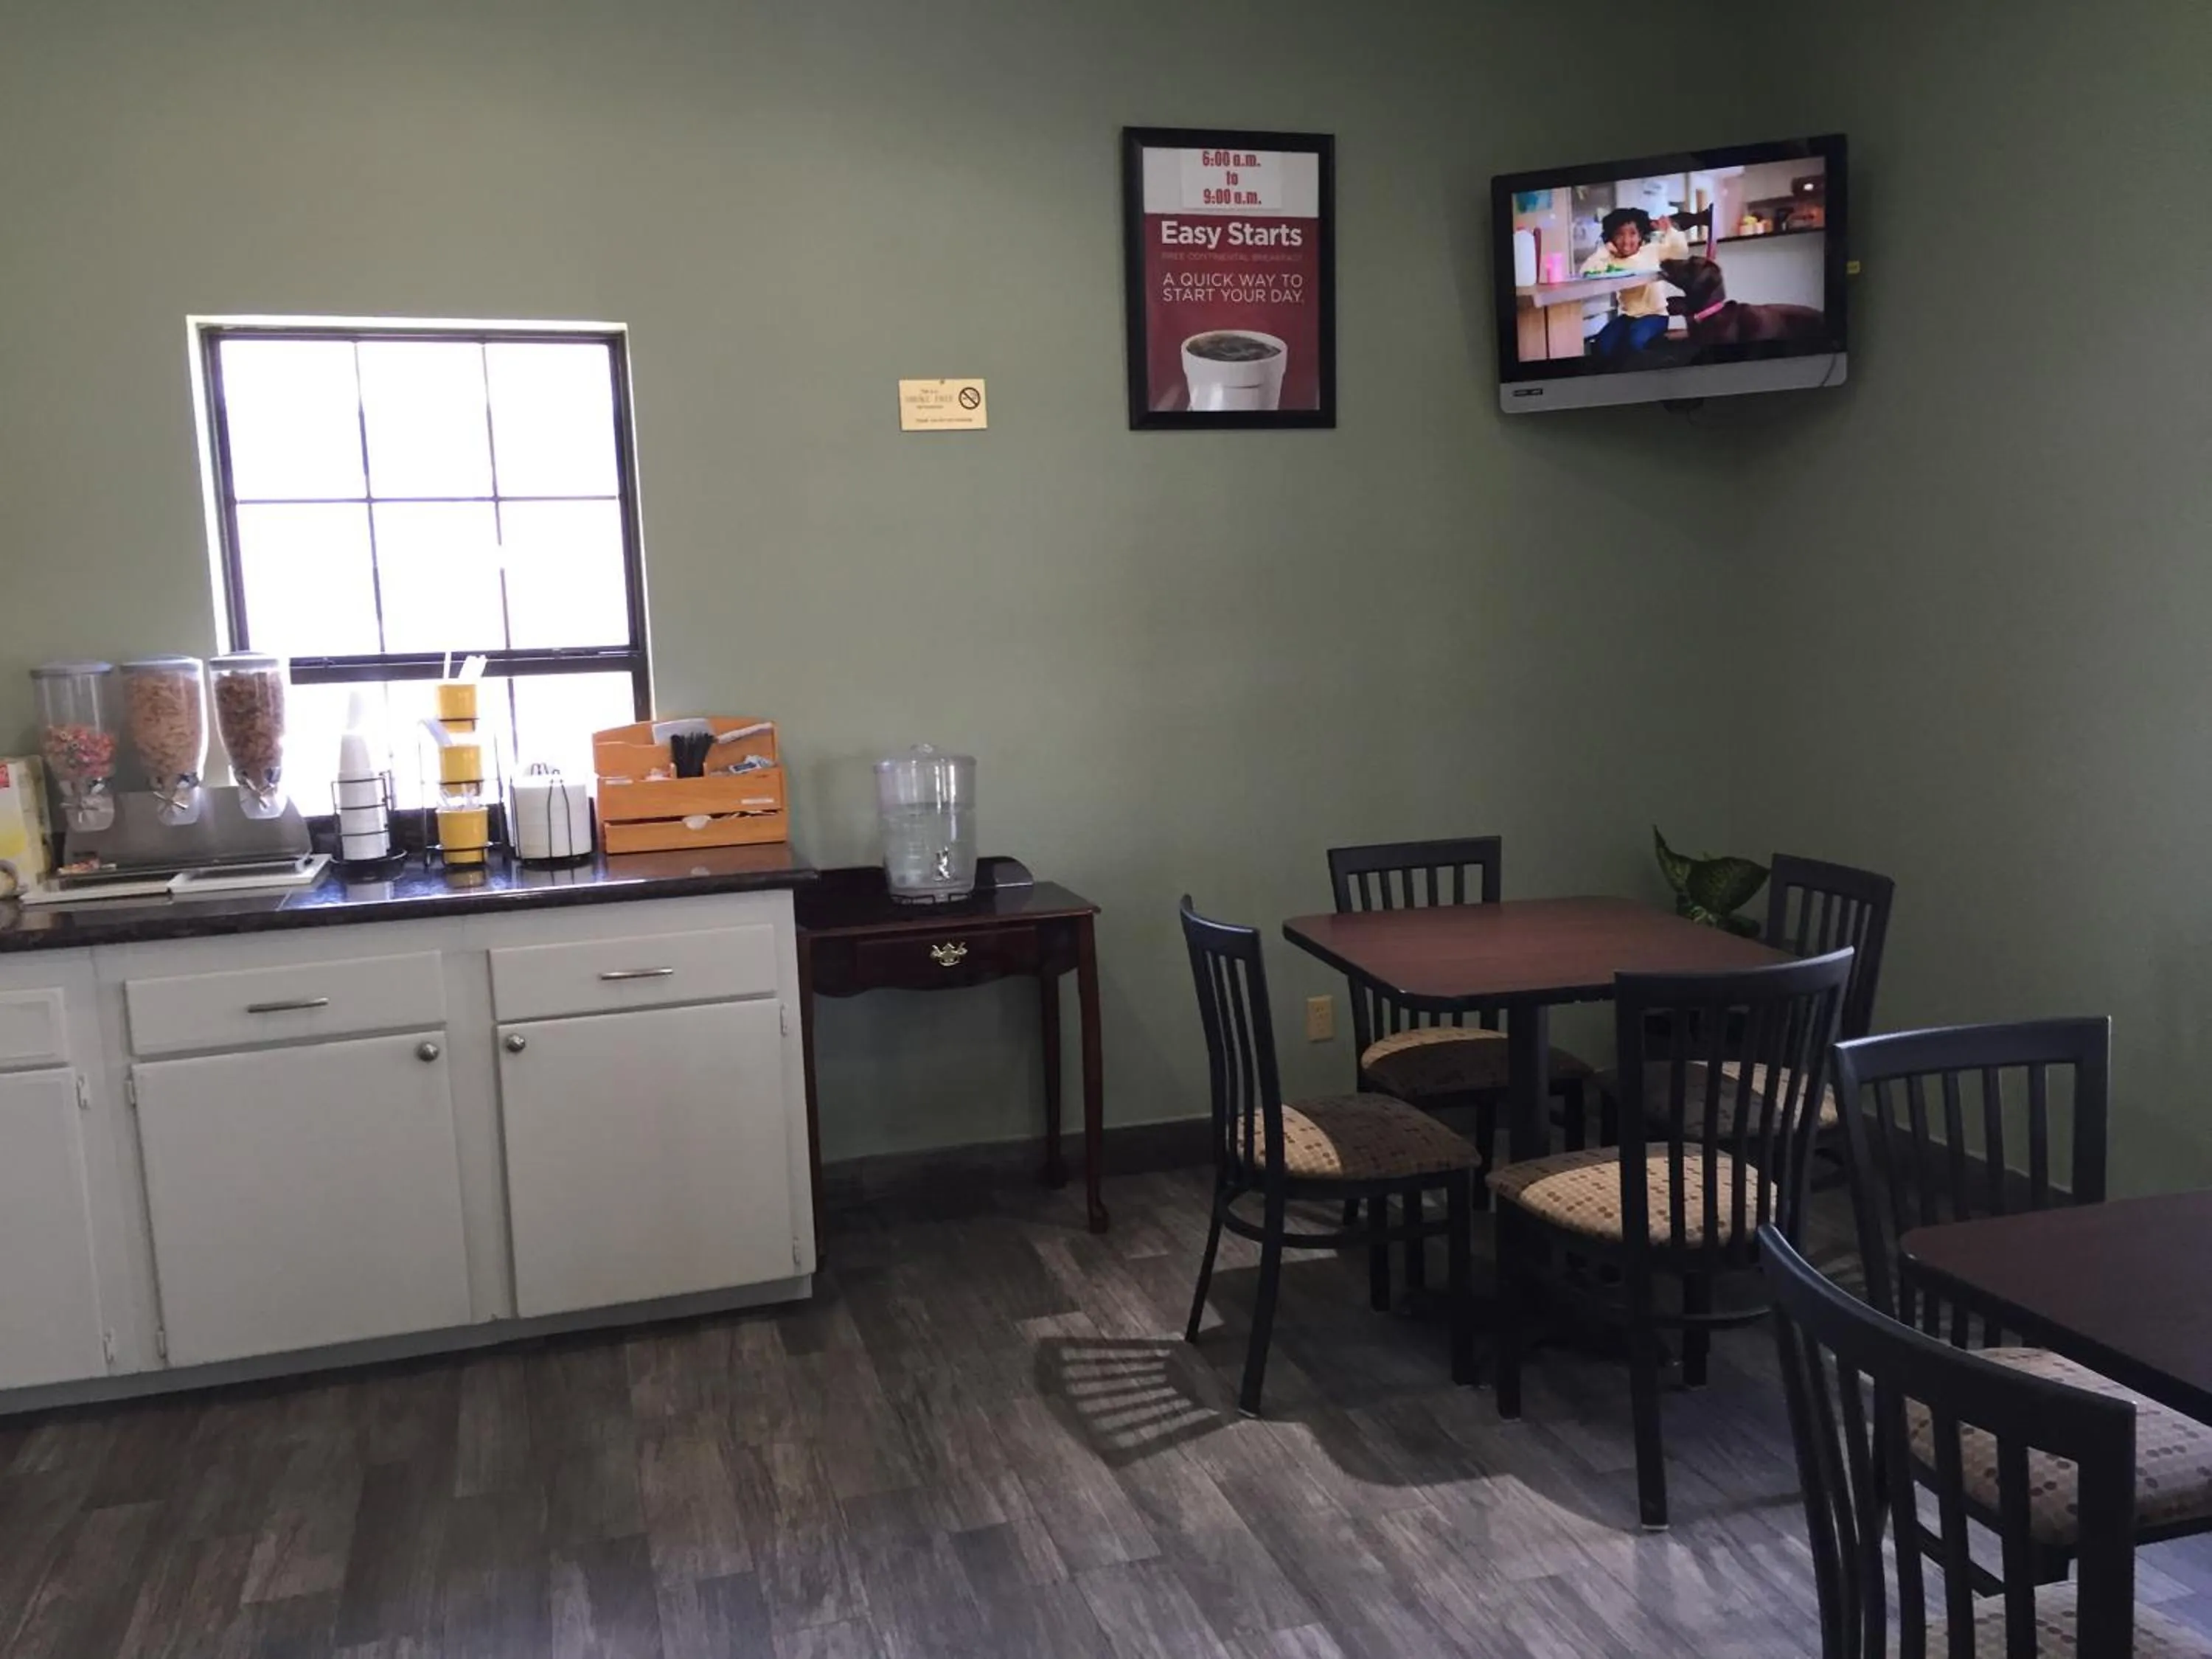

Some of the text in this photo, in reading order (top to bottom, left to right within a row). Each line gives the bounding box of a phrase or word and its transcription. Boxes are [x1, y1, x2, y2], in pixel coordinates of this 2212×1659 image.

[1202, 150, 1262, 167] 6:00 a.m.
[1226, 171, 1239, 186] to
[1203, 188, 1262, 205] 9:00 a.m.
[1161, 220, 1304, 249] Easy Starts
[1163, 272, 1304, 288] A QUICK WAY TO
[1163, 288, 1305, 304] START YOUR DAY.
